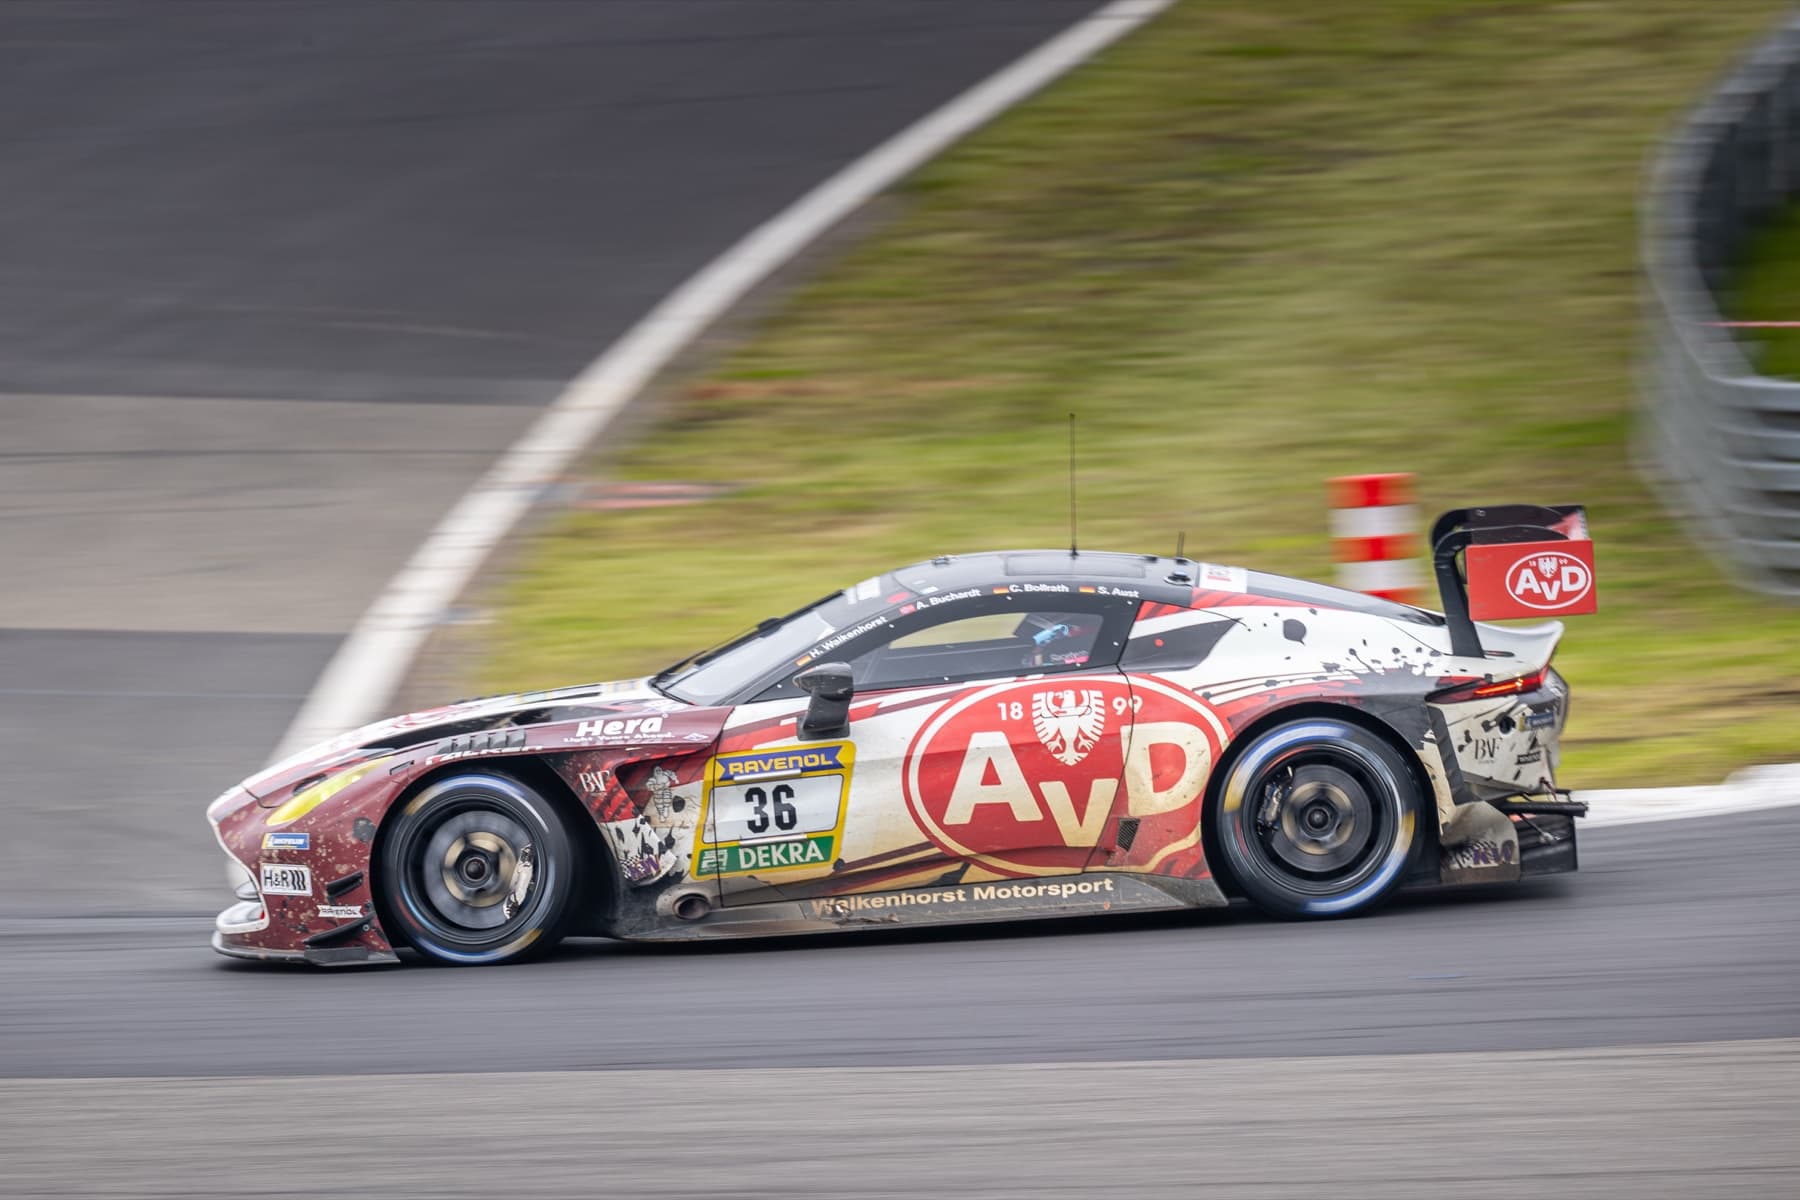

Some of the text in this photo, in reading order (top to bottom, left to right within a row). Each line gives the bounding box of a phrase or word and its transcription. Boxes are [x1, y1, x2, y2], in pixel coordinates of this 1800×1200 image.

[1009, 584, 1023, 593] C.
[1097, 586, 1110, 595] S.
[1515, 566, 1587, 601] AvD
[916, 600, 928, 611] A.
[809, 616, 888, 658] H. Walkenhorst
[997, 701, 1024, 721] 18
[1112, 695, 1144, 716] 99
[576, 716, 664, 737] Hera
[728, 753, 833, 776] RAVENOL
[943, 721, 1213, 848] AvD
[744, 784, 798, 834] 36
[738, 840, 825, 870] DEKRA
[811, 877, 1115, 918] Walkenhorst Motorsport
